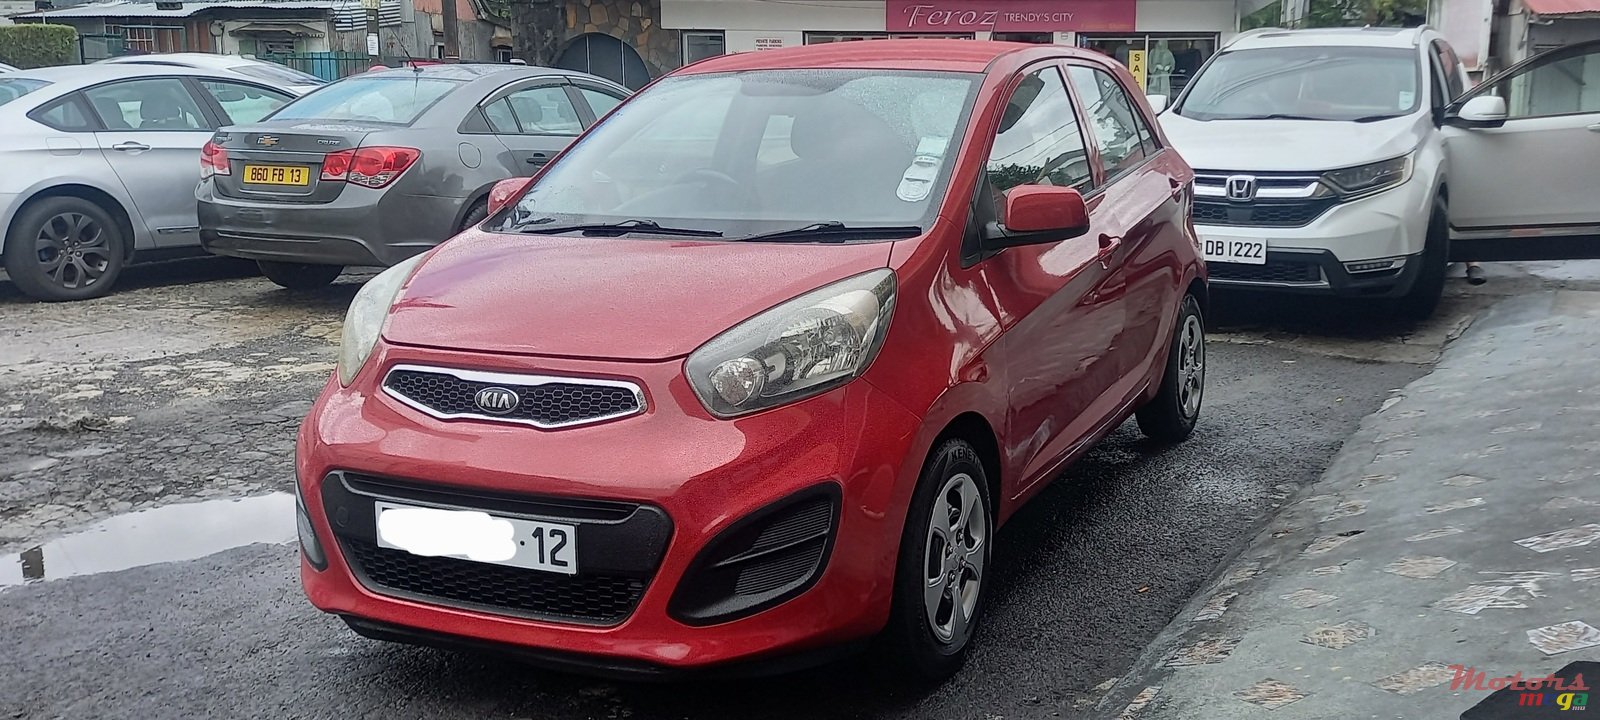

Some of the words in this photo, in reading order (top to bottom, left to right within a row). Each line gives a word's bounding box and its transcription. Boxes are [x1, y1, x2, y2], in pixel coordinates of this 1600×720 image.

[903, 5, 998, 28] Feroz
[1005, 12, 1049, 23] TRENDY'S
[1051, 12, 1074, 22] CITY
[251, 167, 269, 181] 860
[272, 168, 285, 182] FB
[290, 169, 301, 183] 13
[1205, 240, 1225, 256] DB
[1229, 241, 1263, 259] 1222
[480, 391, 512, 409] KIA
